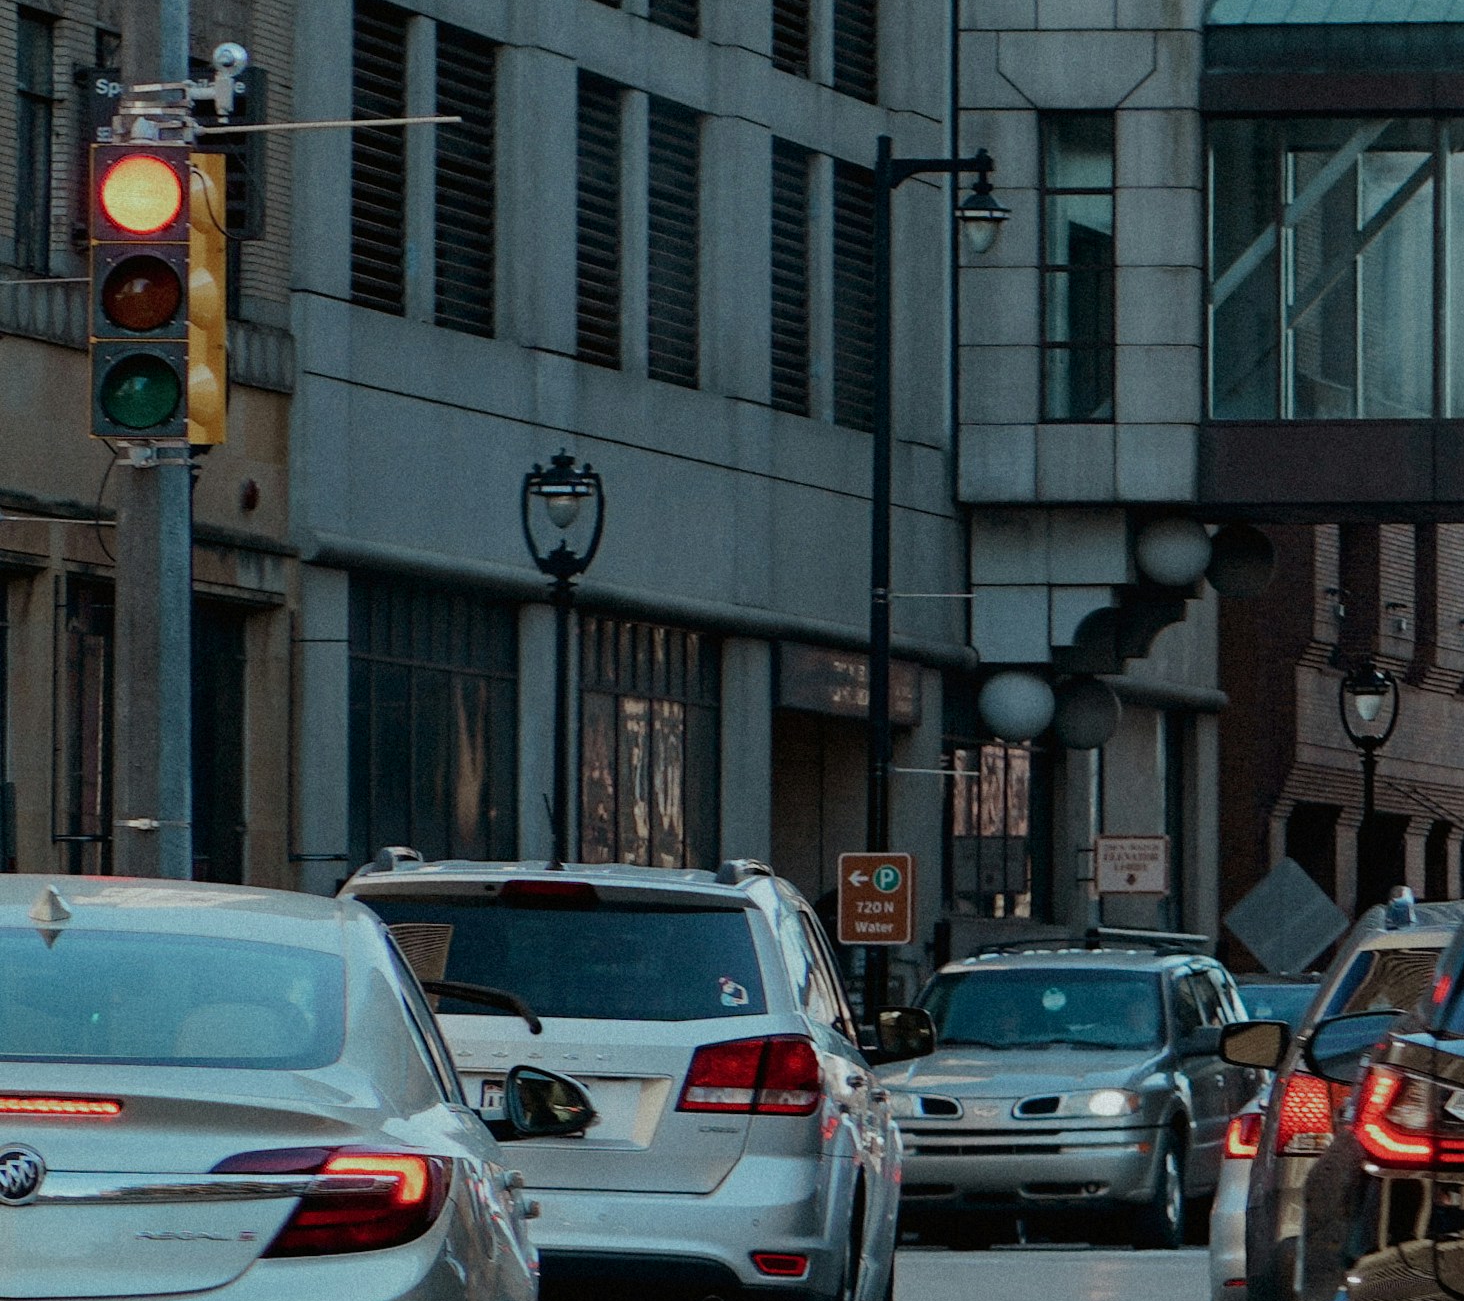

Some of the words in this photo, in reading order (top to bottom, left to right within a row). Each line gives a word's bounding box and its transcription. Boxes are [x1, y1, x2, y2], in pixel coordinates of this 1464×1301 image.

[855, 900, 882, 914] 720
[883, 900, 895, 914] N
[854, 920, 895, 934] Water
